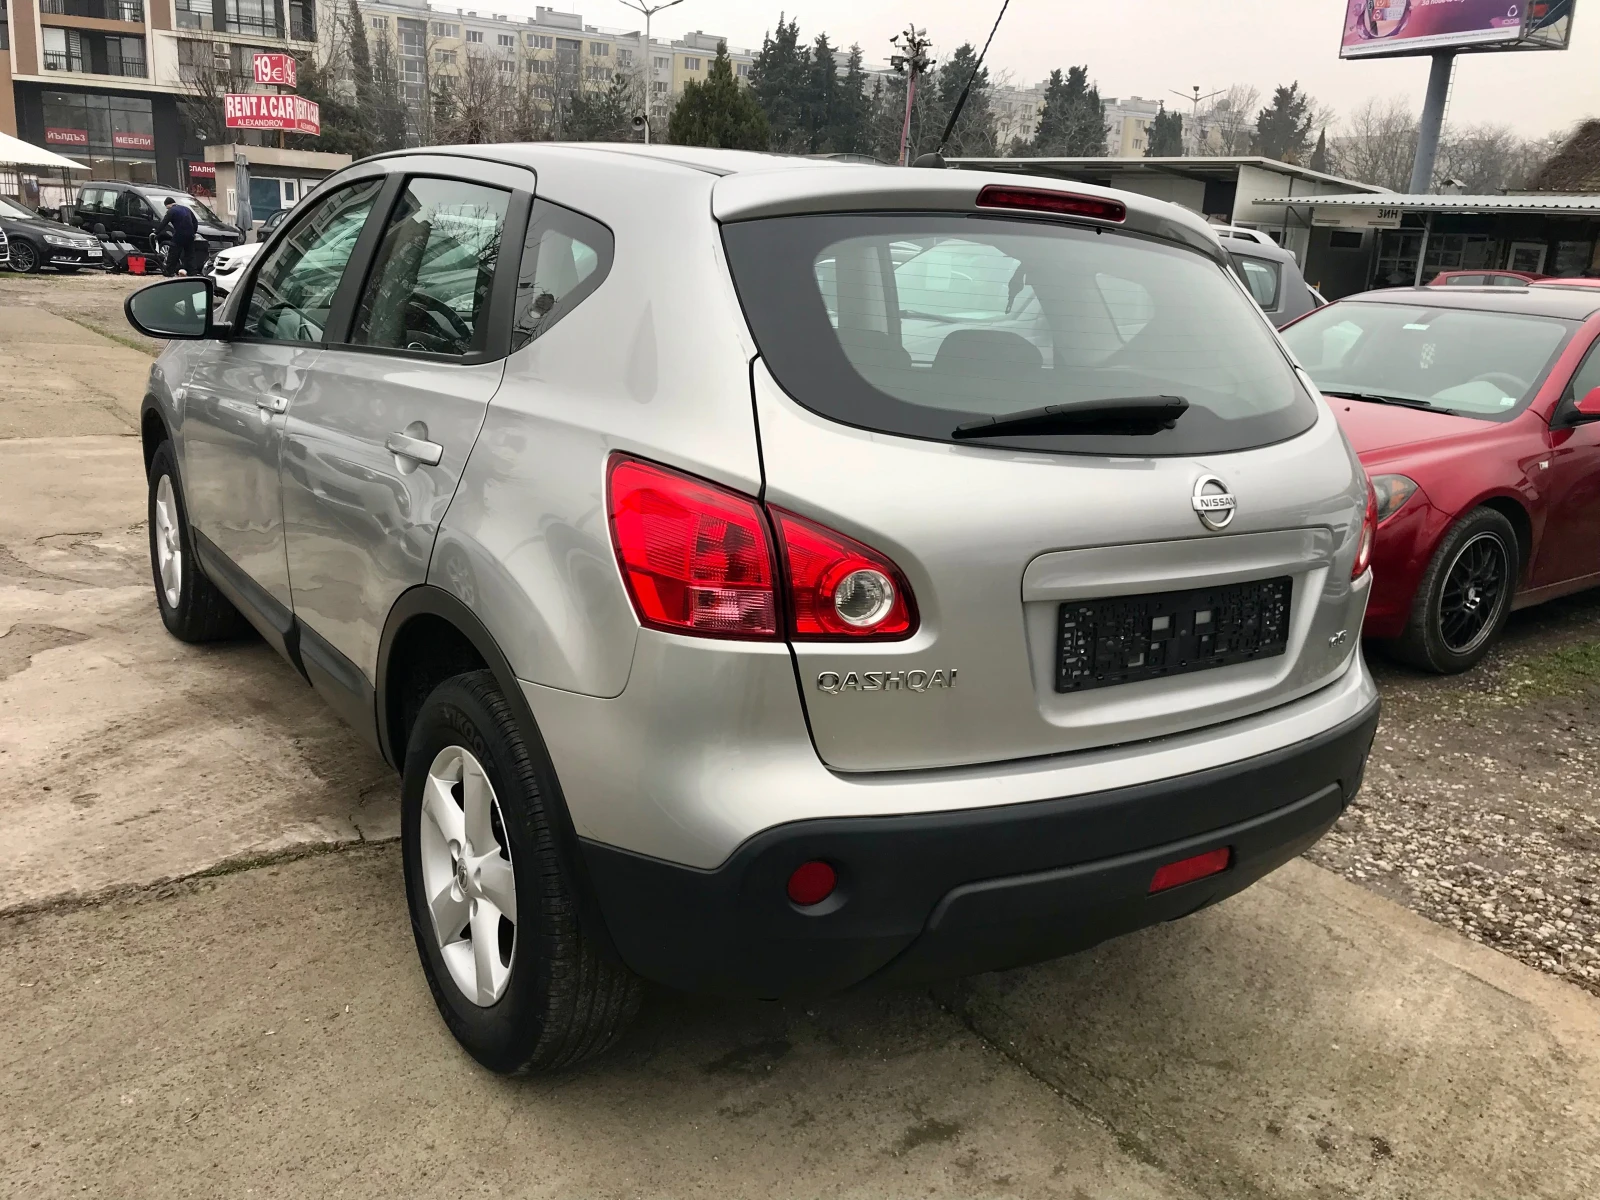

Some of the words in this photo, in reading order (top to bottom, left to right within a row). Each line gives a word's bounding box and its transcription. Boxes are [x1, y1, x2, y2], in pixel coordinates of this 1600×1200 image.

[227, 96, 257, 118] RENT
[260, 96, 268, 117] A
[269, 96, 294, 119] CAR
[237, 118, 284, 127] ALEXANDROV
[115, 136, 151, 146] МЕБЕЛИ
[1200, 497, 1236, 507] NISSAN
[817, 668, 958, 695] QASHQAI
